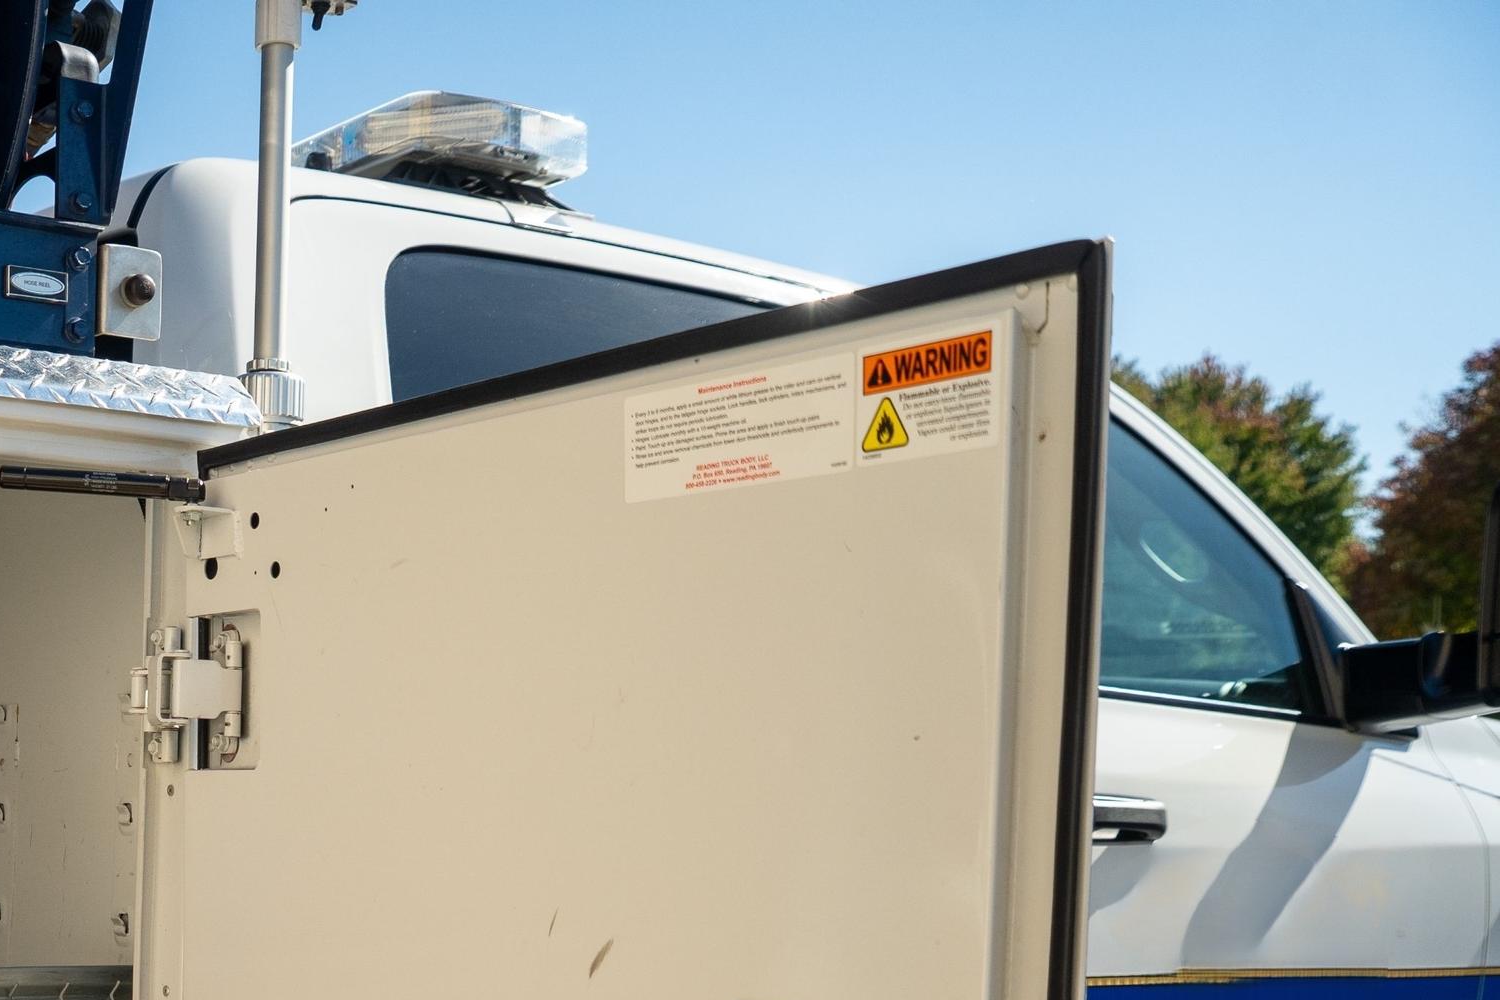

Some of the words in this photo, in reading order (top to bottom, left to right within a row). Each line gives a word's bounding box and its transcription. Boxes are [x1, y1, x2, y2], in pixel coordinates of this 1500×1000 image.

[895, 337, 987, 383] WARNING
[698, 382, 732, 394] Maintenance
[733, 376, 767, 388] Instructions
[899, 386, 940, 402] Flammable
[721, 459, 739, 467] TRUCK
